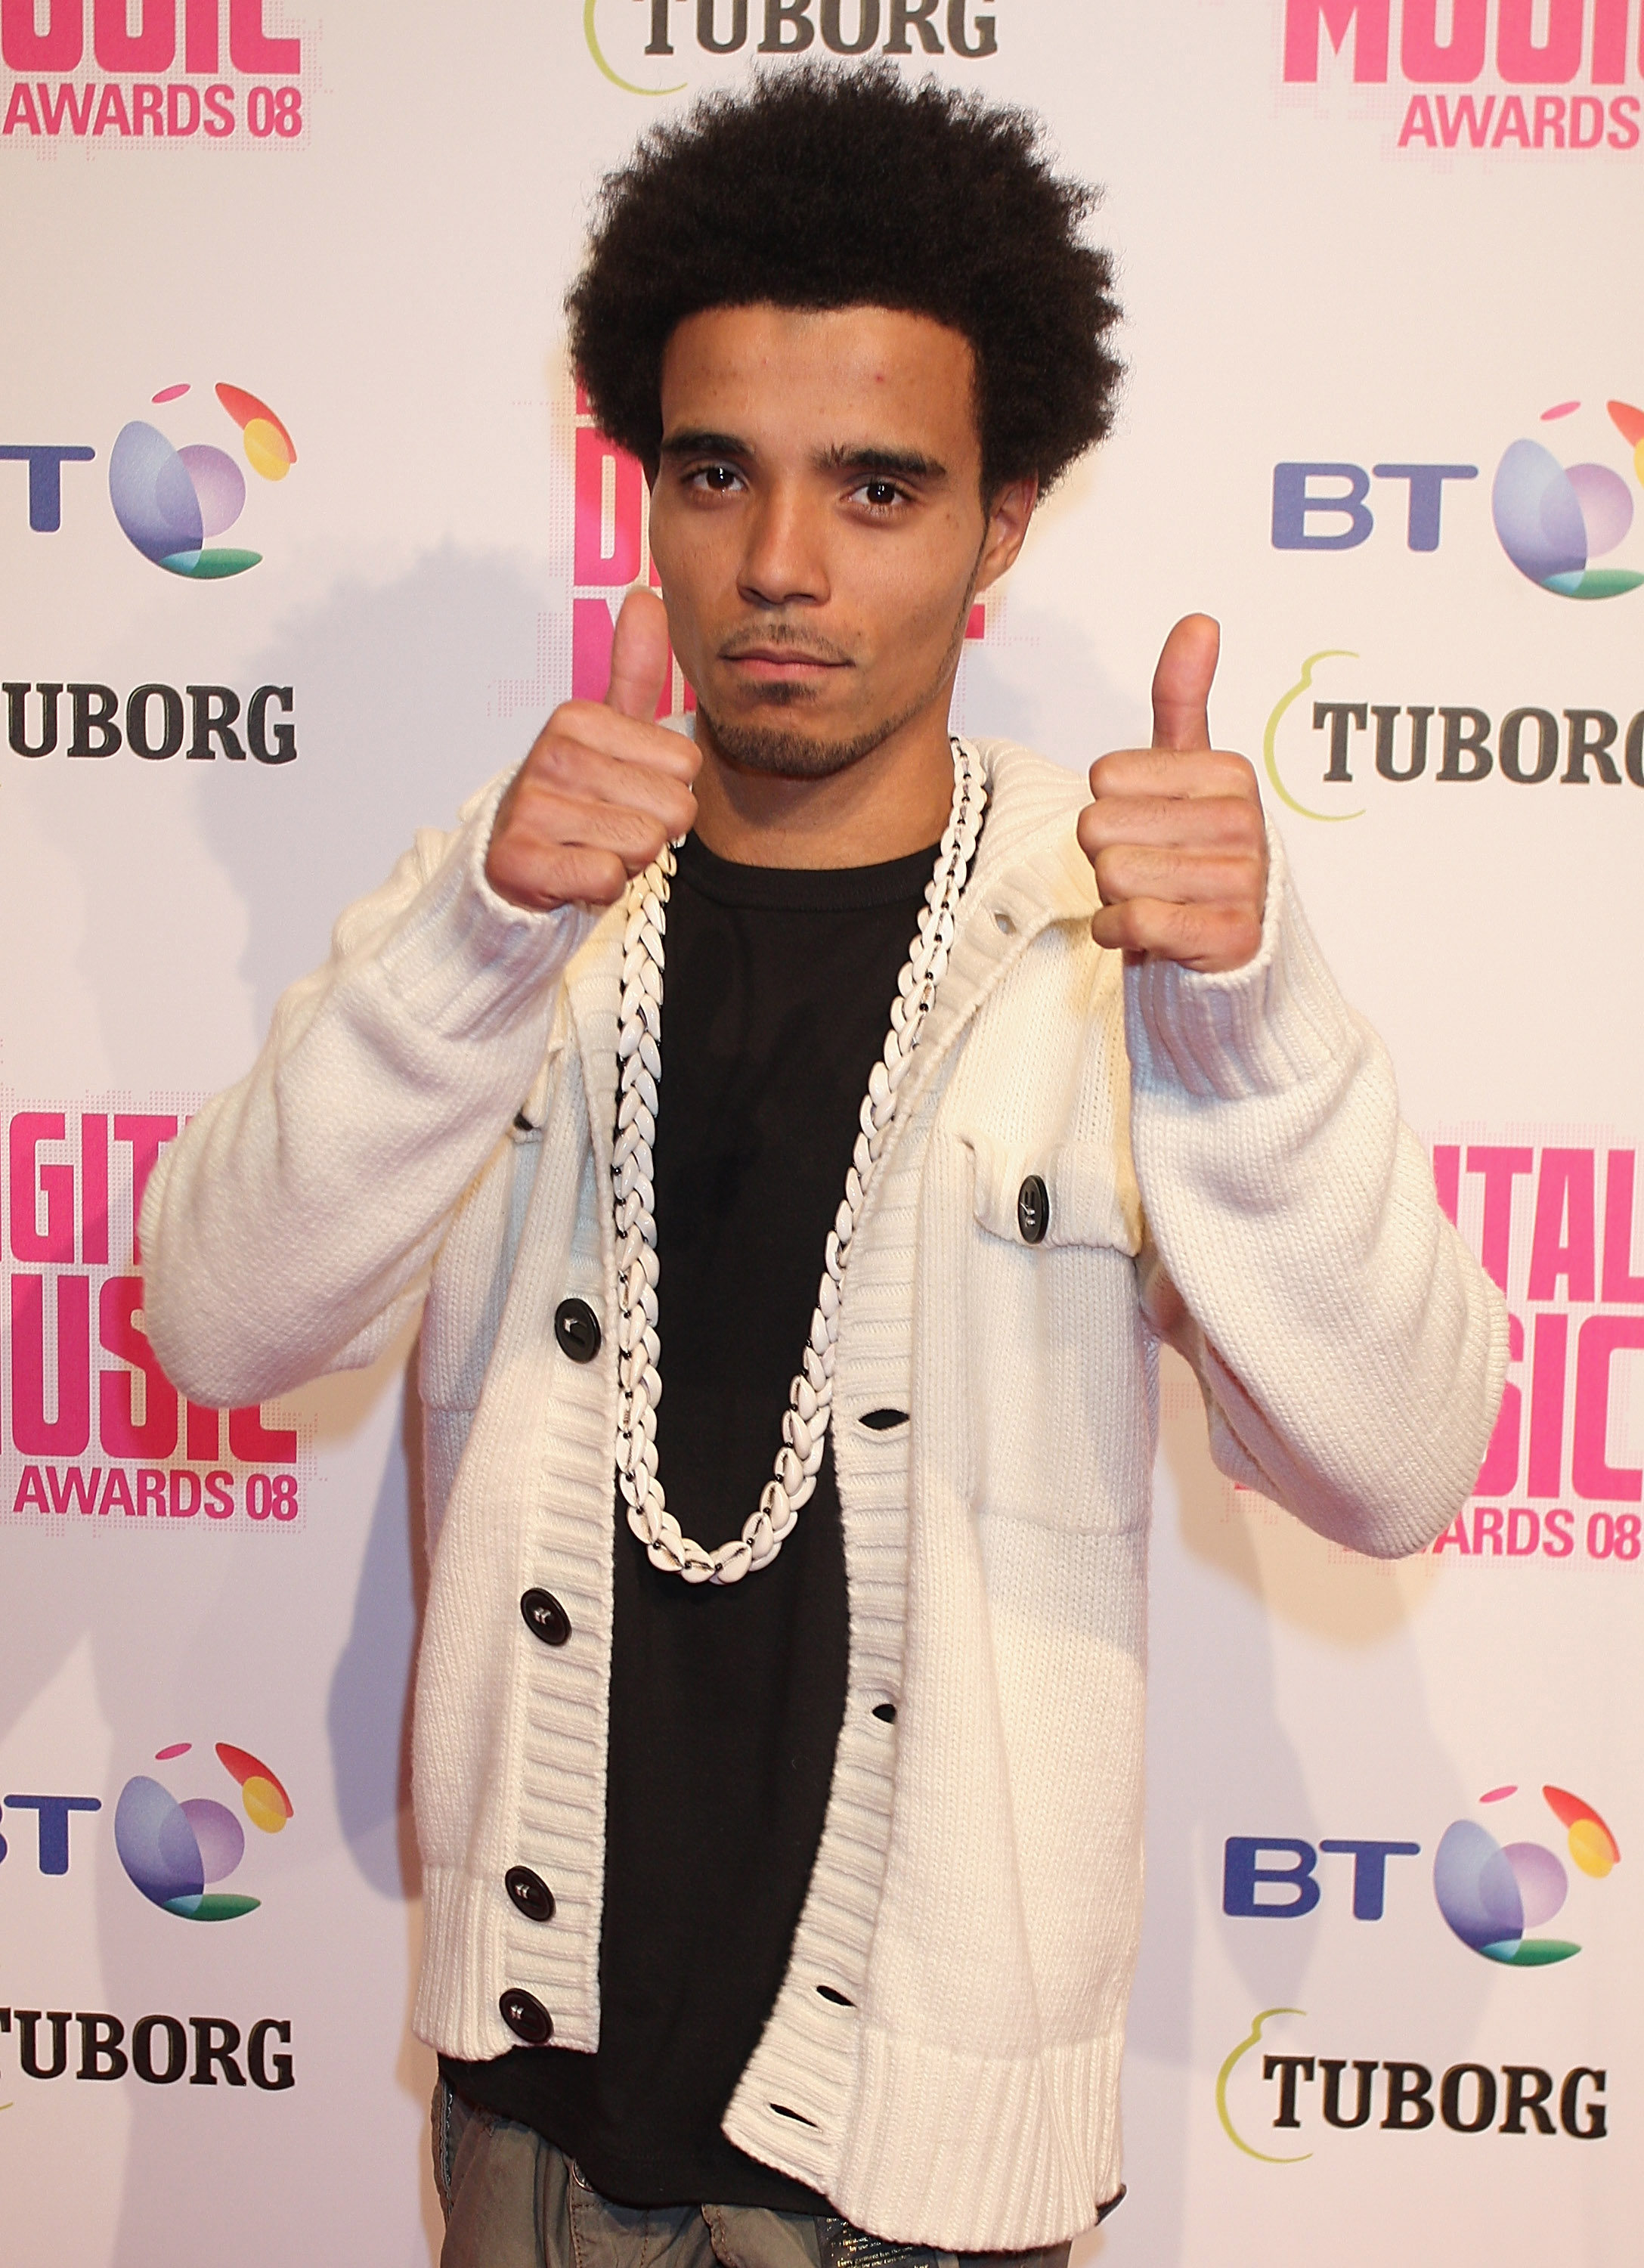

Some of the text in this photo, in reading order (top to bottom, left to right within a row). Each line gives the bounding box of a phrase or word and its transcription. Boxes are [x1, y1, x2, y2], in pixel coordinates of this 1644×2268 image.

[641, 0, 998, 58] TUBORG
[3, 83, 302, 138] AWARDS 08
[1398, 94, 1640, 150] AWARDS
[1271, 462, 1479, 552] BT
[2, 682, 298, 764] UBORG
[9, 1112, 195, 1265] GIT
[13, 1465, 299, 1521] AWARDS 08
[1431, 1507, 1642, 1560] ARDS 08
[0, 1795, 102, 1875] T
[1223, 1837, 1421, 1921] BT
[0, 2007, 296, 2091] UBORG
[1263, 2055, 1608, 2139] TUBORG
